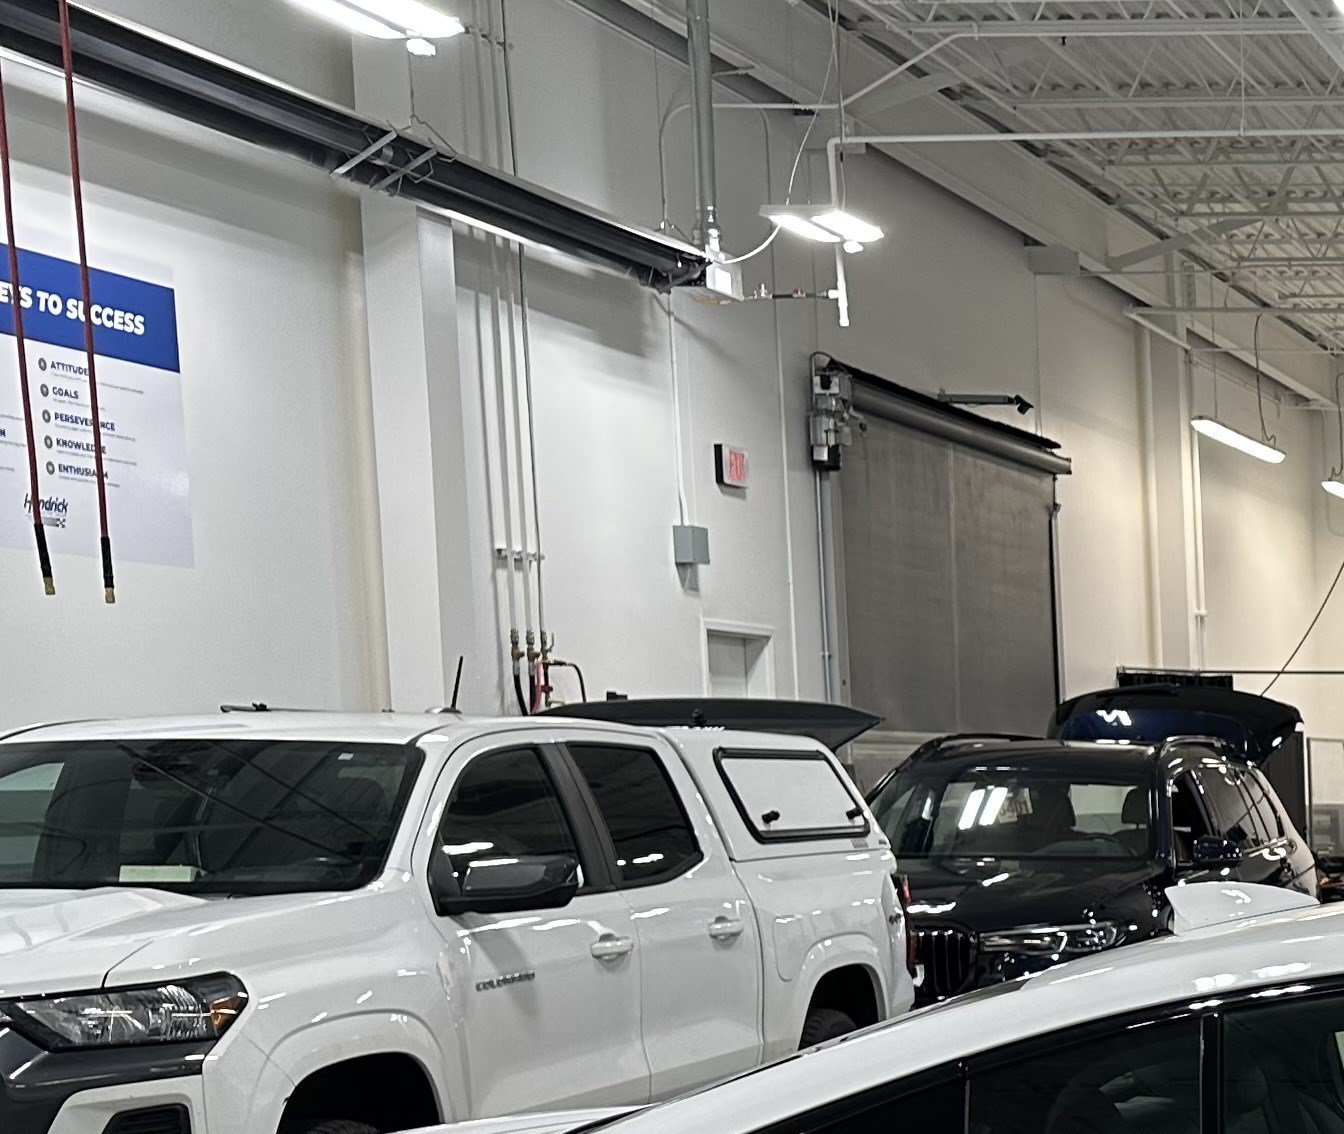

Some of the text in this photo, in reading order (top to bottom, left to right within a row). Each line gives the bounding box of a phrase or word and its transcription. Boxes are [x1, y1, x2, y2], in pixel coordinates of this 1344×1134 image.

[36, 290, 63, 316] TO
[52, 386, 79, 400] GOALS
[24, 492, 69, 515] Hndrick
